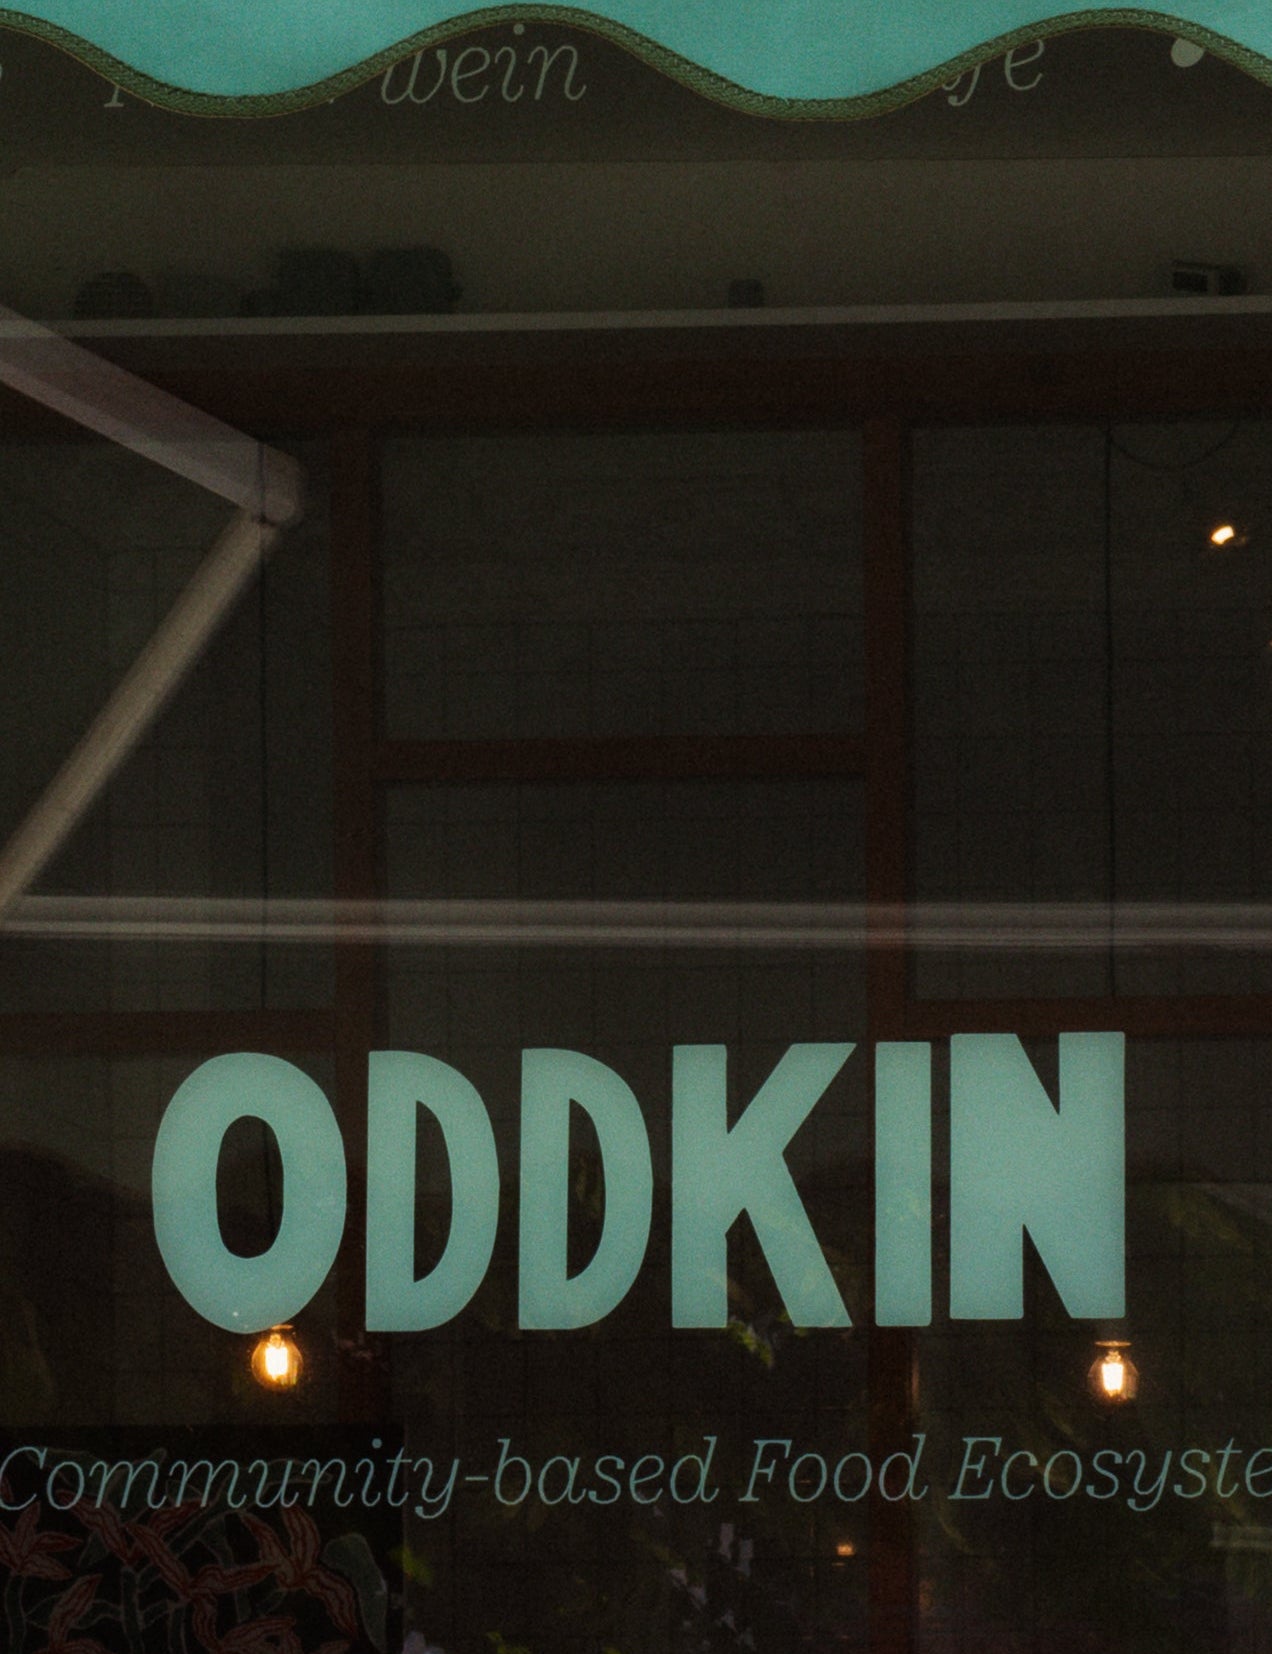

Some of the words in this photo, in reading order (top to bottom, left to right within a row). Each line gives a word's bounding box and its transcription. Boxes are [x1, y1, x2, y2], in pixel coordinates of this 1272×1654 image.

[152, 1033, 1124, 1333] ODDKIN
[0, 1436, 719, 1519] Community-based
[739, 1434, 928, 1502] Food
